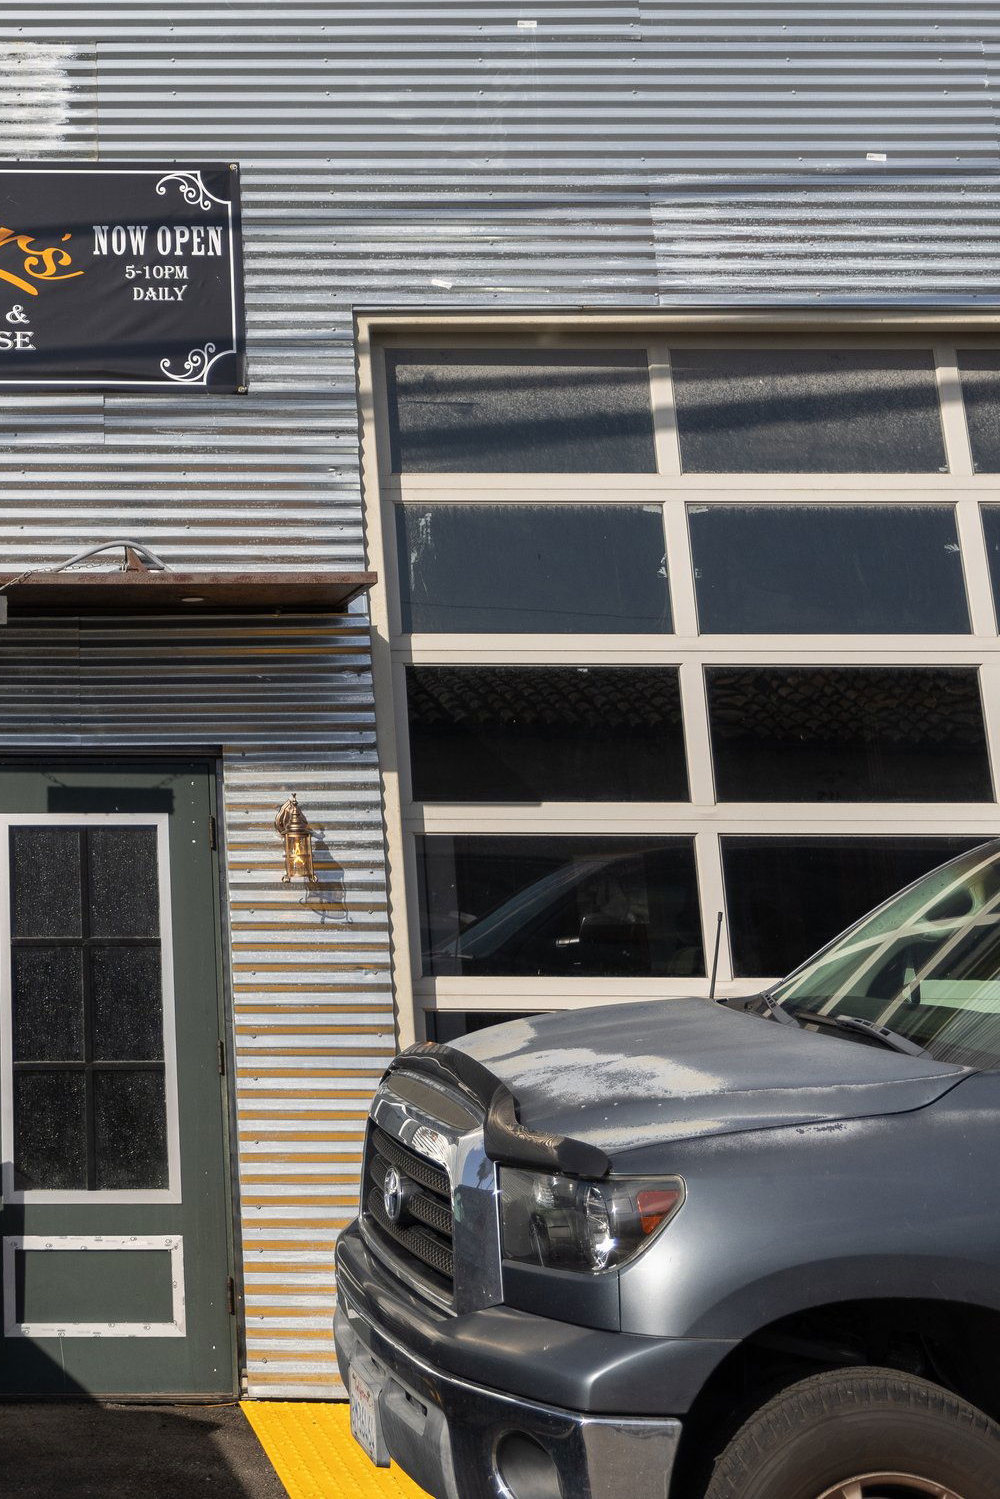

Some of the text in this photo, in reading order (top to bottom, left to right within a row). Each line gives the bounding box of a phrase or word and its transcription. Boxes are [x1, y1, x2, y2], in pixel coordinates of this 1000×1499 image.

[93, 226, 223, 256] NOW OPEN
[125, 265, 189, 280] 5-10PM
[133, 285, 188, 301] DAILY
[5, 304, 30, 324] &
